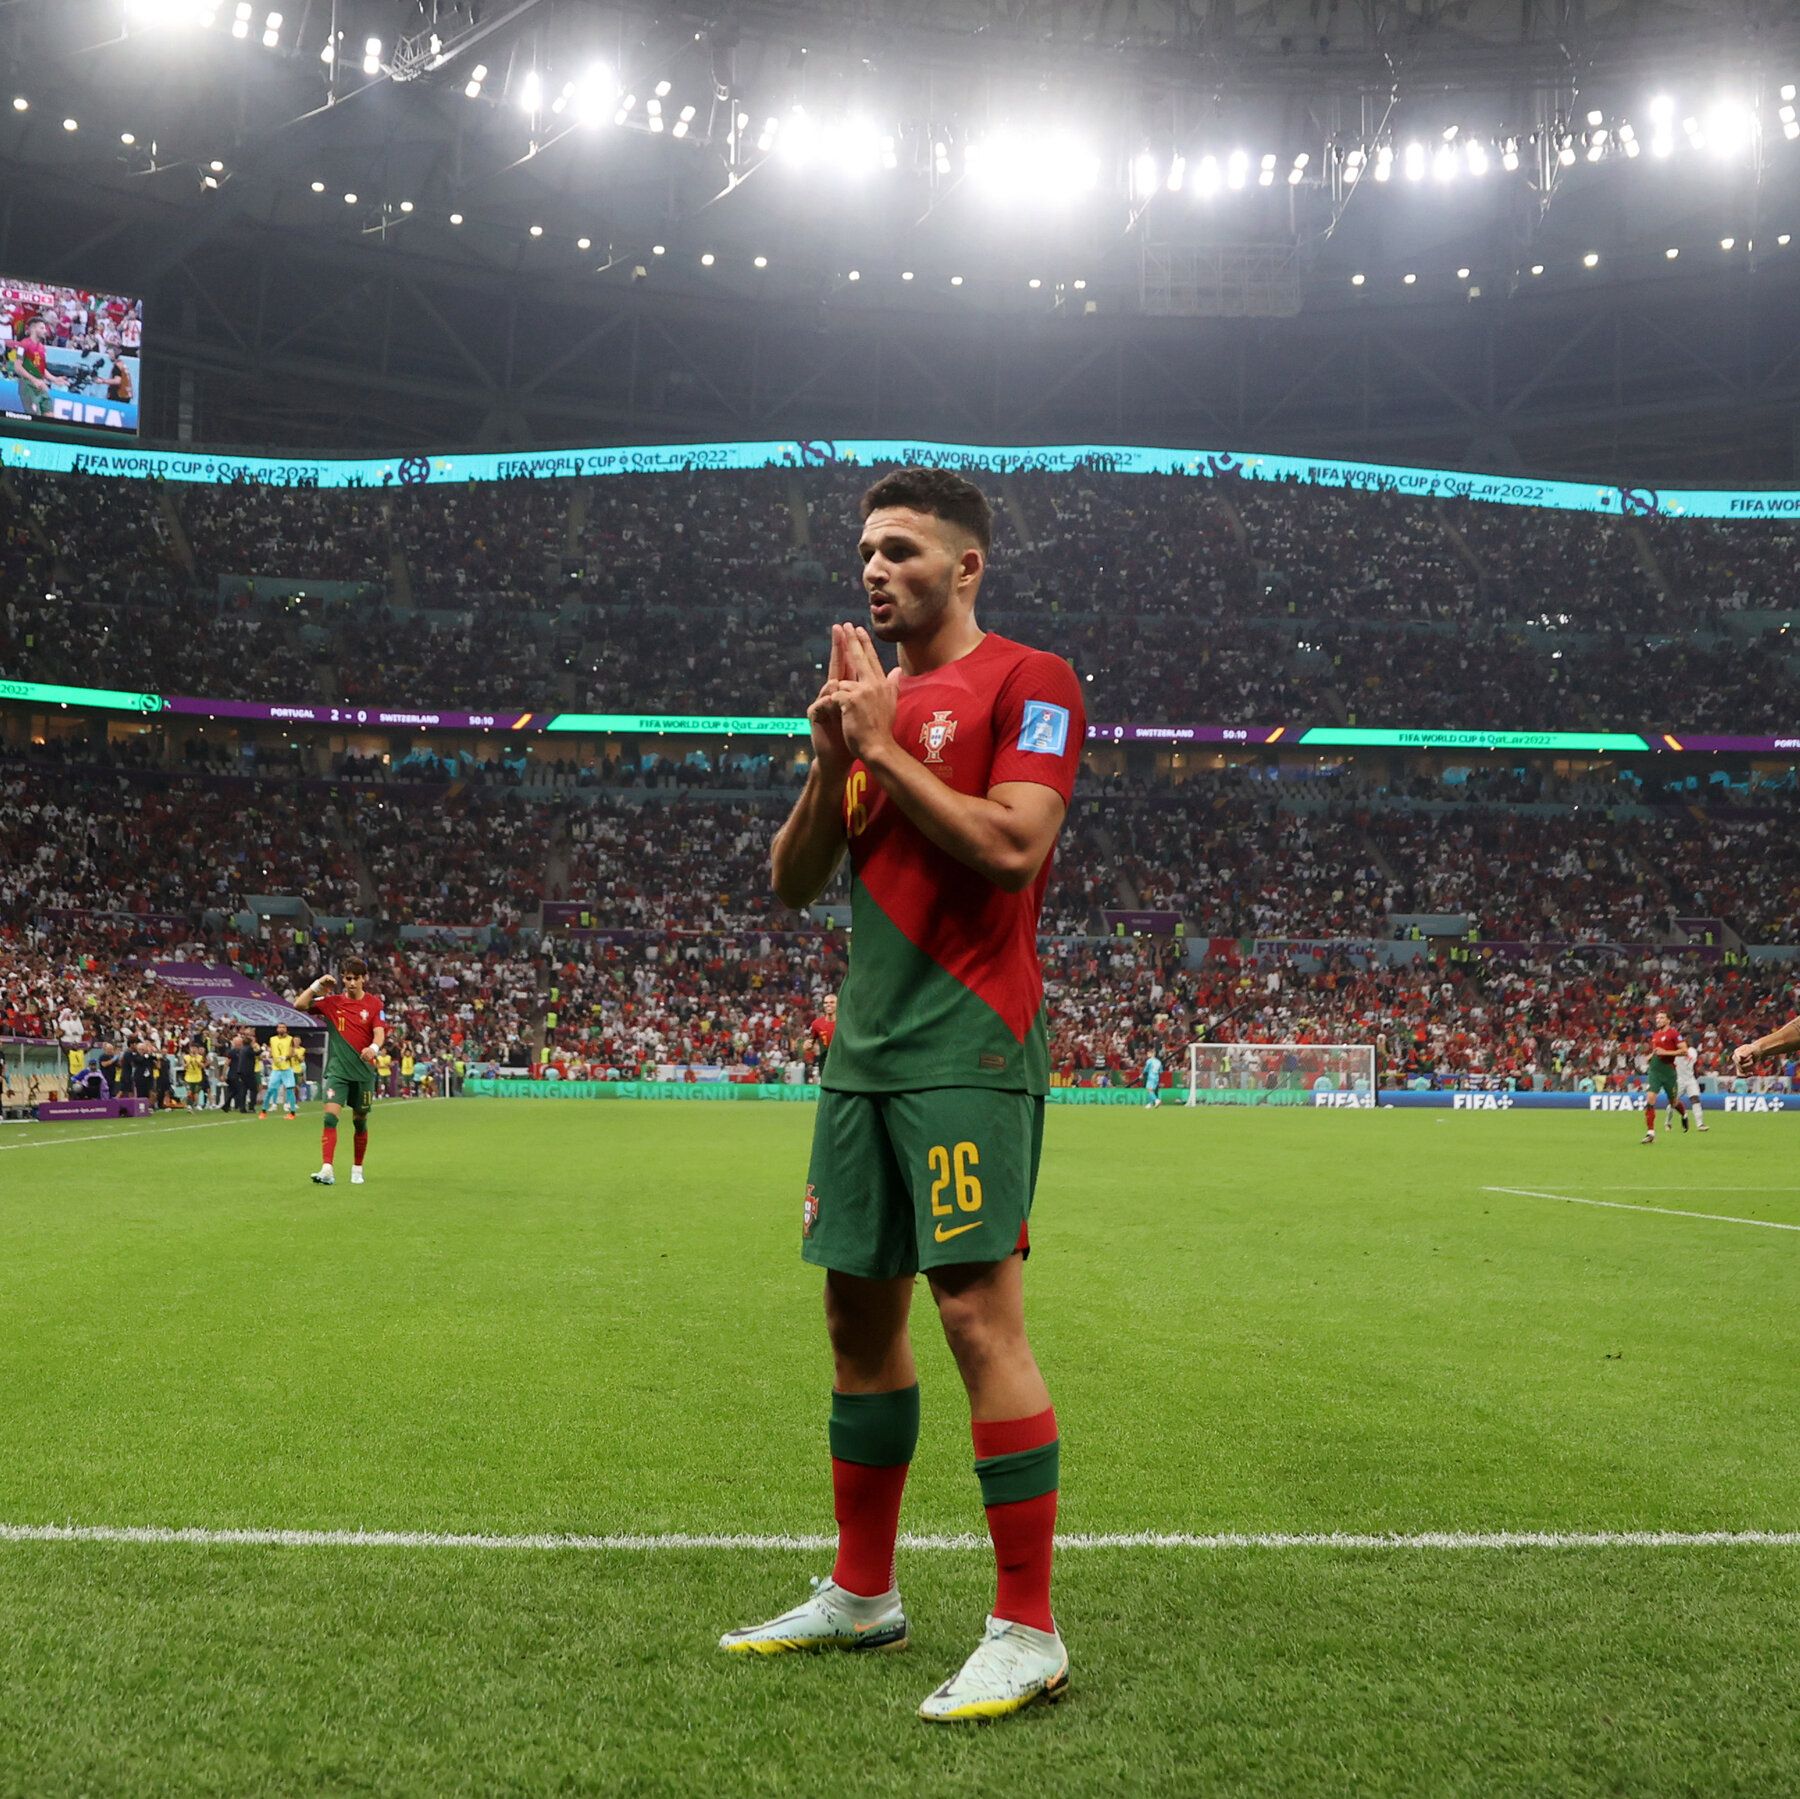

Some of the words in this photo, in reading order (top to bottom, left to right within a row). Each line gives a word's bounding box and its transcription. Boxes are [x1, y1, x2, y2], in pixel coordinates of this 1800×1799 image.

[53, 398, 122, 428] FIFA
[75, 453, 109, 469] FIFA
[112, 456, 169, 474] WORLD
[171, 460, 202, 476] CUP
[498, 458, 527, 475] FIFA
[531, 456, 585, 472] WORLD
[587, 455, 616, 468] CUP
[902, 447, 934, 461] FIFA
[935, 450, 989, 466] WORLD
[991, 453, 1021, 467] CUP
[1307, 466, 1340, 480] FIFA
[1342, 469, 1396, 486] WORLD
[1398, 473, 1428, 488] CUP
[1730, 499, 1765, 512] FIFA
[270, 707, 315, 720] PORTUGAL
[330, 709, 340, 721] 2
[357, 710, 368, 723] 0
[379, 712, 440, 725] SWITZERLAND
[639, 719, 661, 729] FIFA
[662, 719, 700, 729] WORLD
[700, 720, 721, 730] CUP
[1088, 725, 1097, 738] 2
[1113, 726, 1124, 738] 0
[1135, 728, 1195, 739] SWITZERLAND
[1399, 733, 1420, 743] FIFA
[1421, 733, 1458, 743] WORLD
[1458, 734, 1478, 744] CUP
[338, 1016, 346, 1032] 11
[500, 1081, 597, 1099] MENGNIU
[641, 1083, 738, 1100] MENGNIU
[927, 1141, 983, 1217] 26
